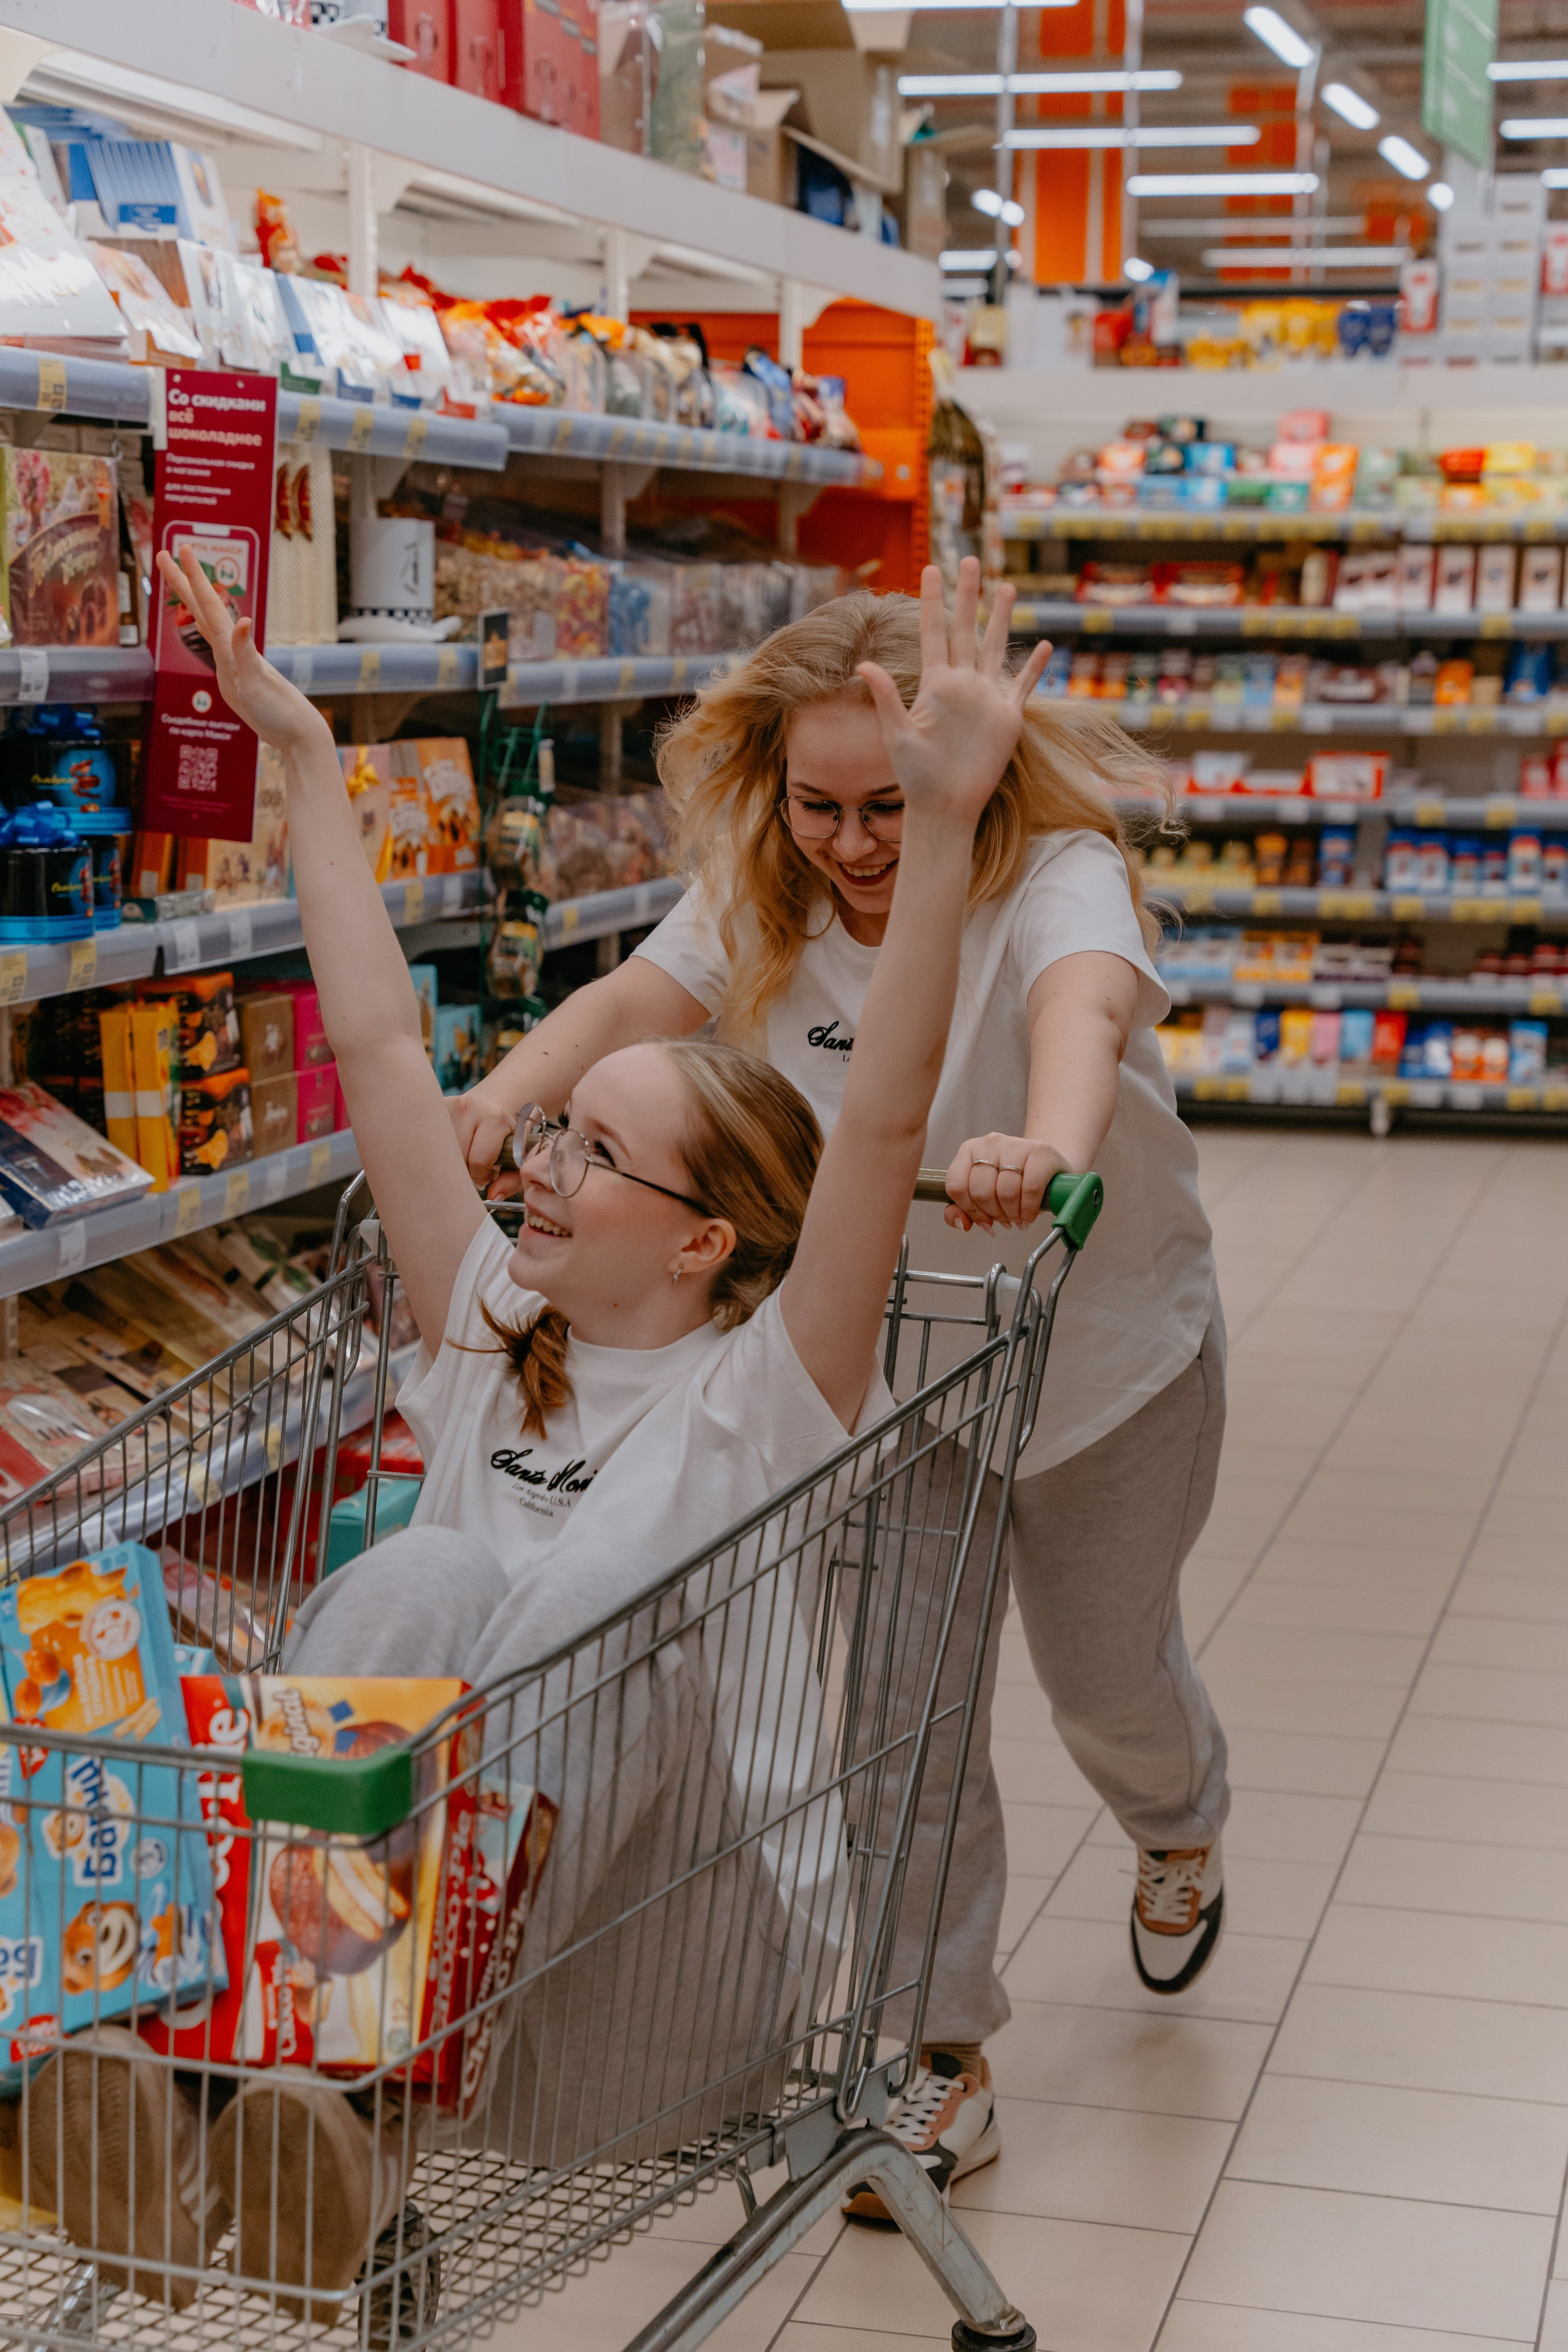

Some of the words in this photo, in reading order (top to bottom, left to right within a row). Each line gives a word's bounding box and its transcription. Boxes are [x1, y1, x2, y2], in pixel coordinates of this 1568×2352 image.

[168, 388, 190, 405] Со
[191, 394, 266, 412] скидками
[168, 407, 194, 424] всё
[168, 428, 262, 447] шоколаднее
[807, 1020, 855, 1051] Sant
[491, 1449, 548, 1485] Santa
[547, 1459, 598, 1493] Moni
[512, 1483, 524, 1492] Los
[524, 1489, 549, 1503] Angeles
[519, 1497, 554, 1517] California
